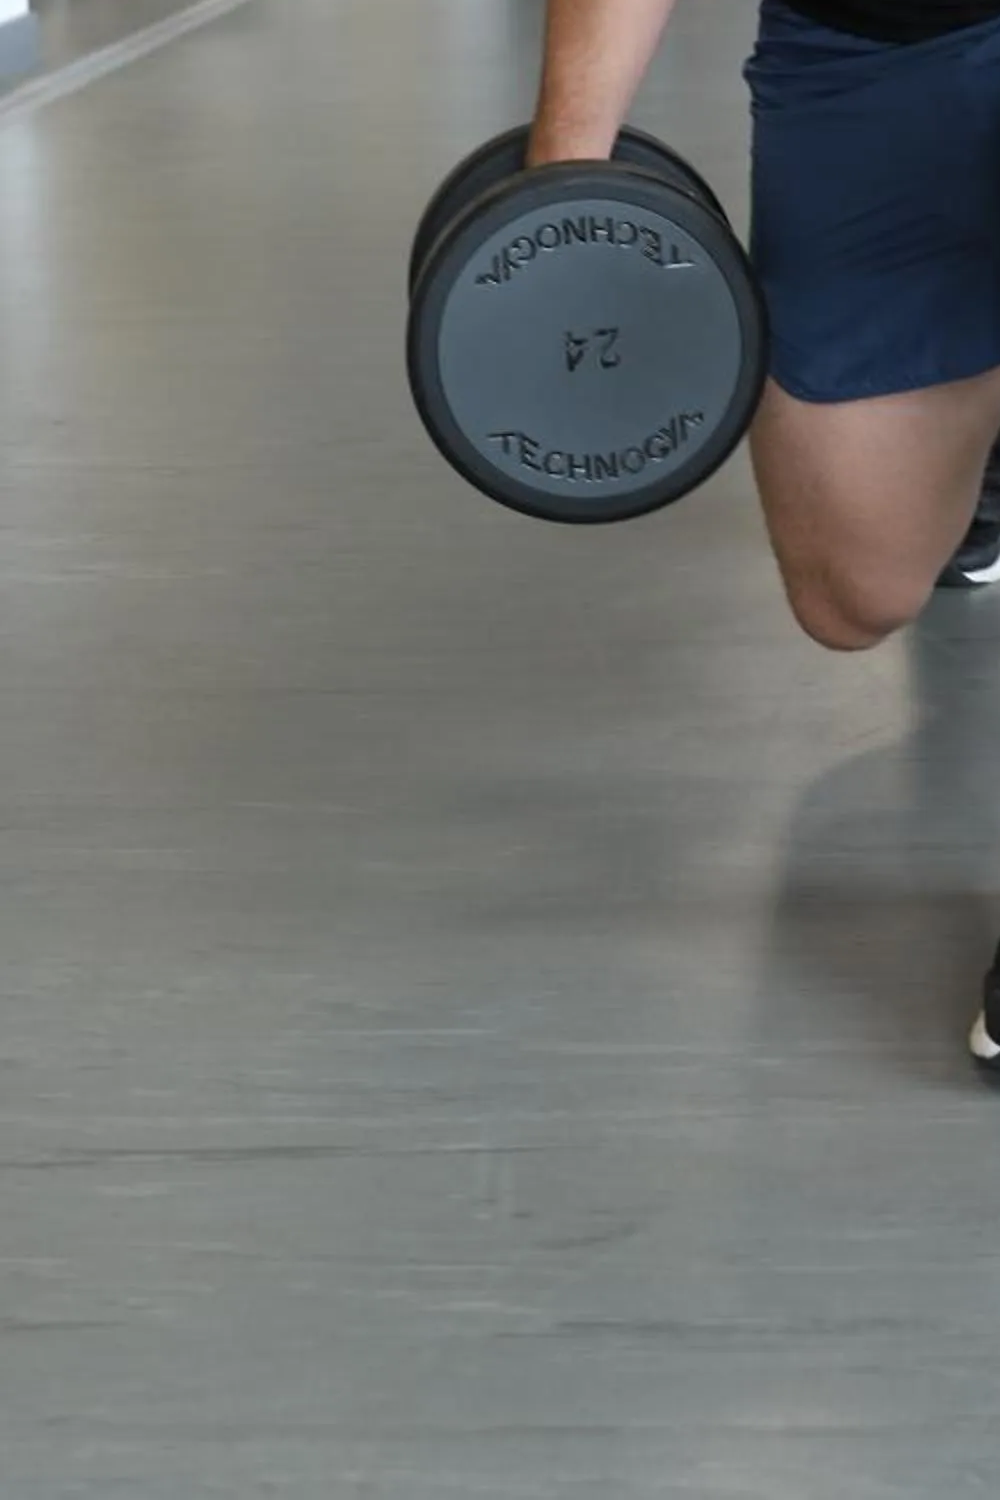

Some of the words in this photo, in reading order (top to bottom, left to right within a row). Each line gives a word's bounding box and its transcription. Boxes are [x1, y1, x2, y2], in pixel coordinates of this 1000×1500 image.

[474, 216, 697, 286] TECHNOGYM
[563, 327, 621, 372] 24
[487, 409, 705, 481] TECHNOGYM
